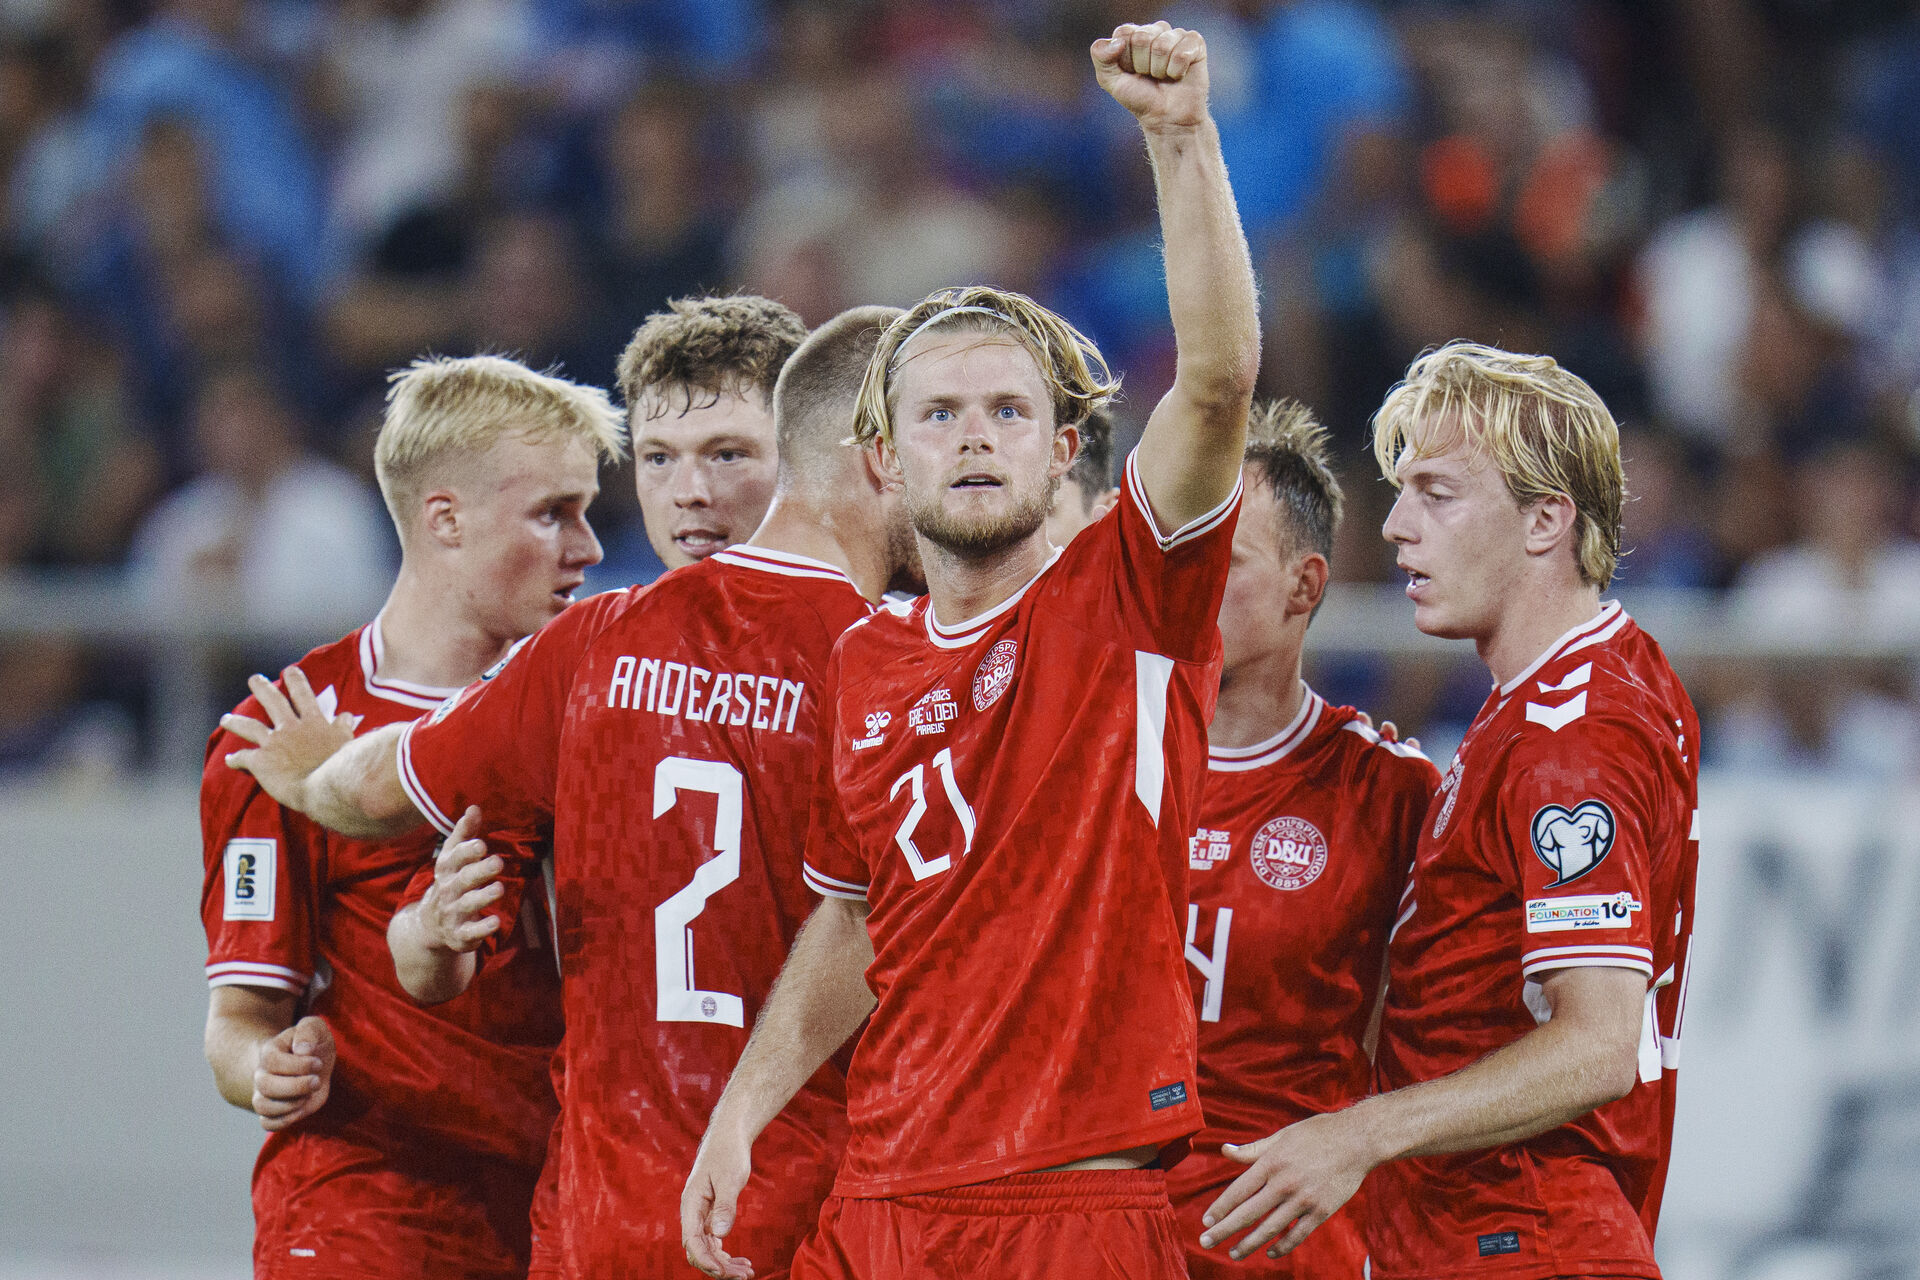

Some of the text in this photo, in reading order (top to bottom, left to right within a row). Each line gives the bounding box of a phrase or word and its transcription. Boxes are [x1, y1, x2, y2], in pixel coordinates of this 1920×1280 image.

[982, 659, 1014, 695] DBU
[607, 655, 805, 733] ANDERSEN
[933, 702, 959, 722] DEN
[916, 722, 946, 736] PIRAEUS
[852, 733, 885, 752] hummel
[889, 747, 977, 882] 21
[1265, 838, 1312, 866] DBU
[1303, 845, 1325, 882] UNION
[652, 755, 745, 1028] 2
[1269, 875, 1301, 888] 1889
[1529, 901, 1547, 909] UEFA
[1529, 908, 1600, 921] FOUNDATION
[1601, 902, 1628, 919] 10
